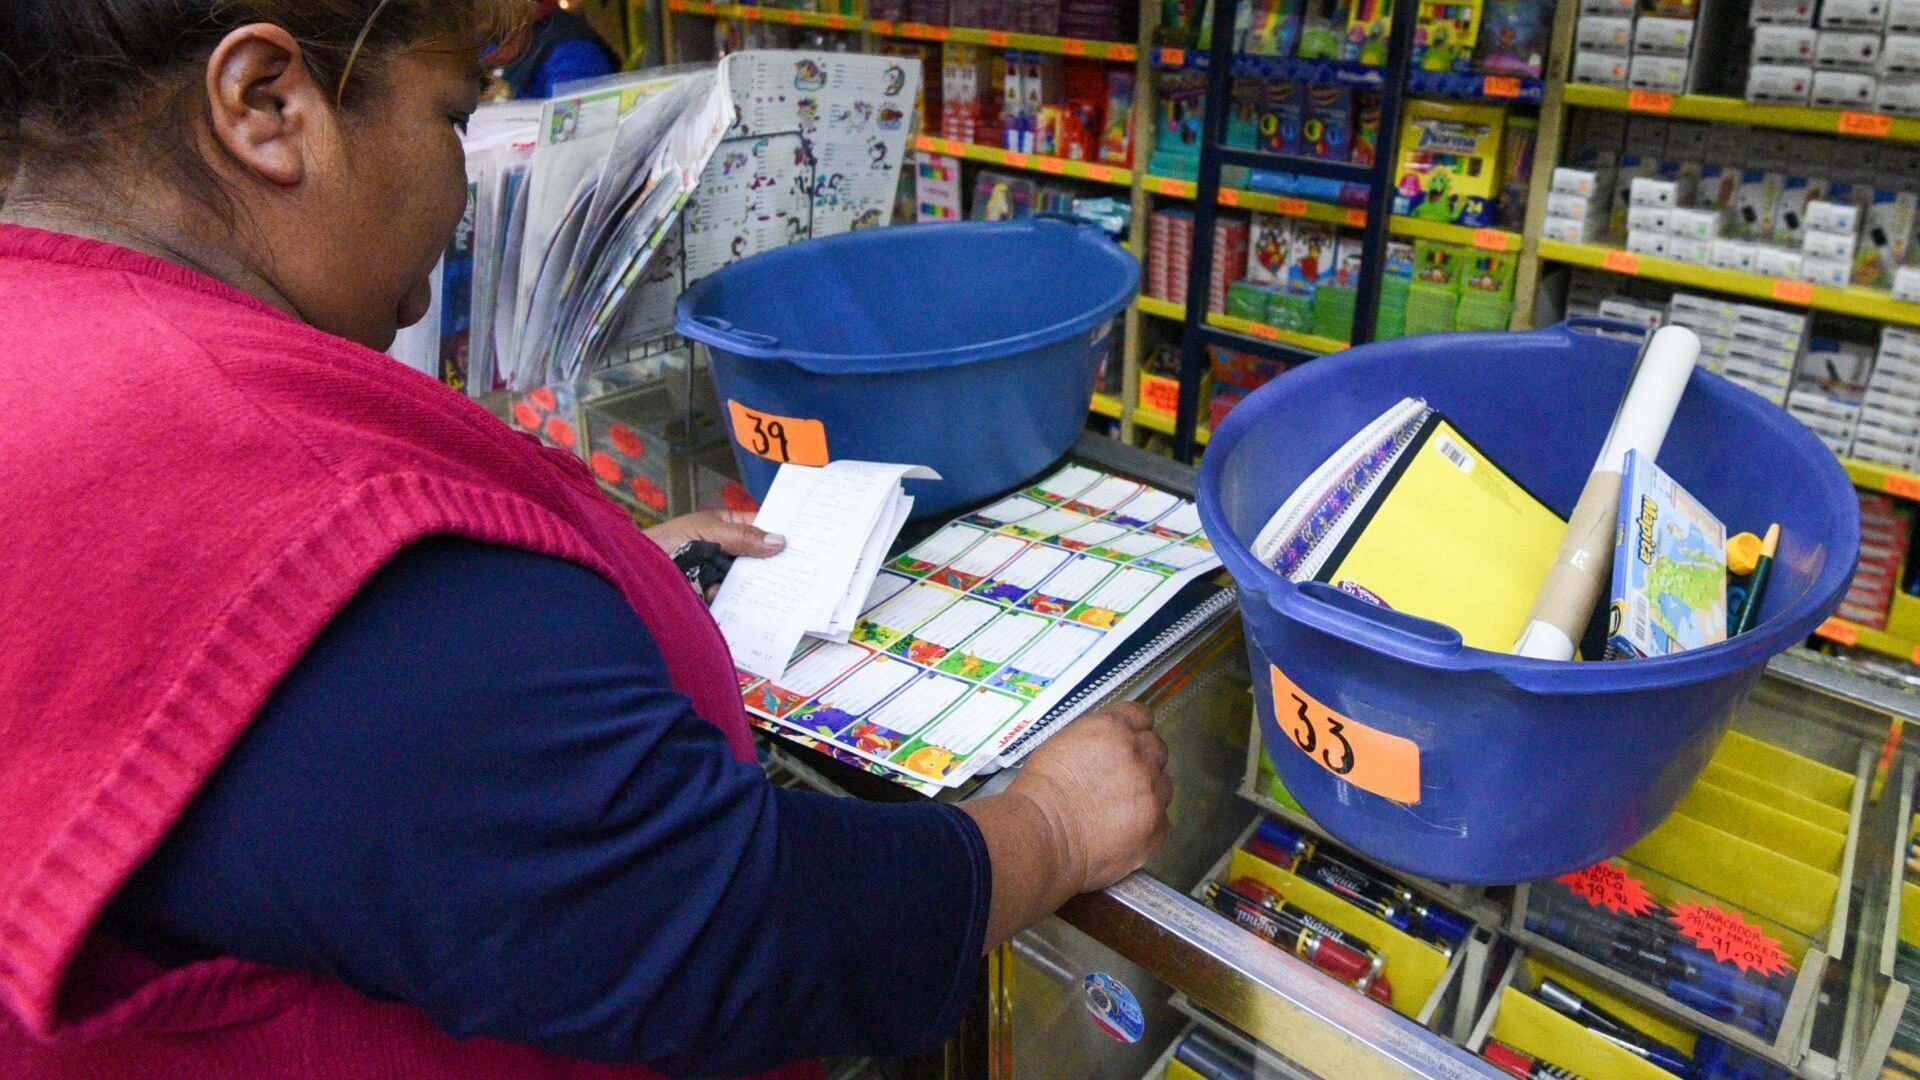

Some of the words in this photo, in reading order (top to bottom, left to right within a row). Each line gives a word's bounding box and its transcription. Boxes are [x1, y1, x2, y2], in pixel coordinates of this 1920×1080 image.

[746, 413, 789, 462] 39
[1637, 494, 1659, 565] Mapita
[997, 718, 1033, 748] JANEL
[1291, 693, 1354, 774] 33
[1236, 906, 1279, 938] Signal
[1686, 912, 1723, 936] PAINT
